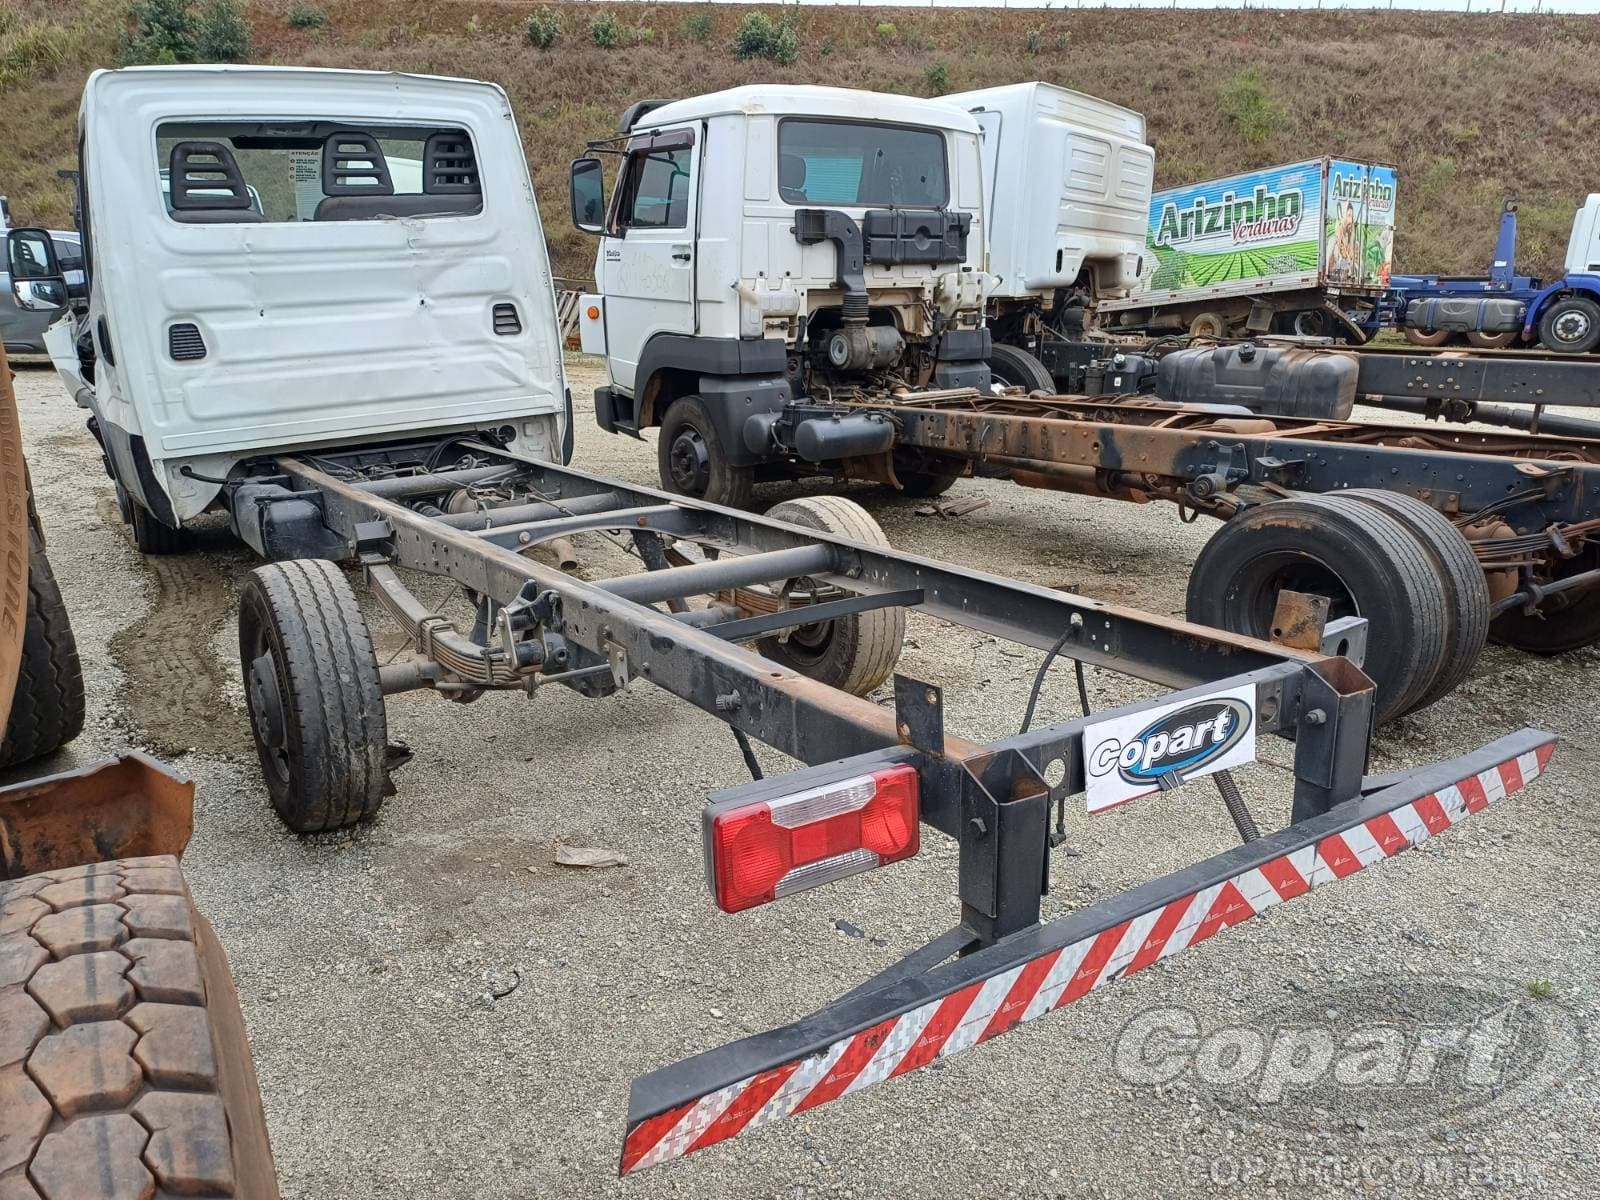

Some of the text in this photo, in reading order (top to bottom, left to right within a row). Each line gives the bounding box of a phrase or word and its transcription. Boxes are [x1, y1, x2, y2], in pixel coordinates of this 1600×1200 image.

[1156, 187, 1301, 243] Arizinho
[1232, 217, 1297, 241] Verduras
[1088, 704, 1232, 778] Copart
